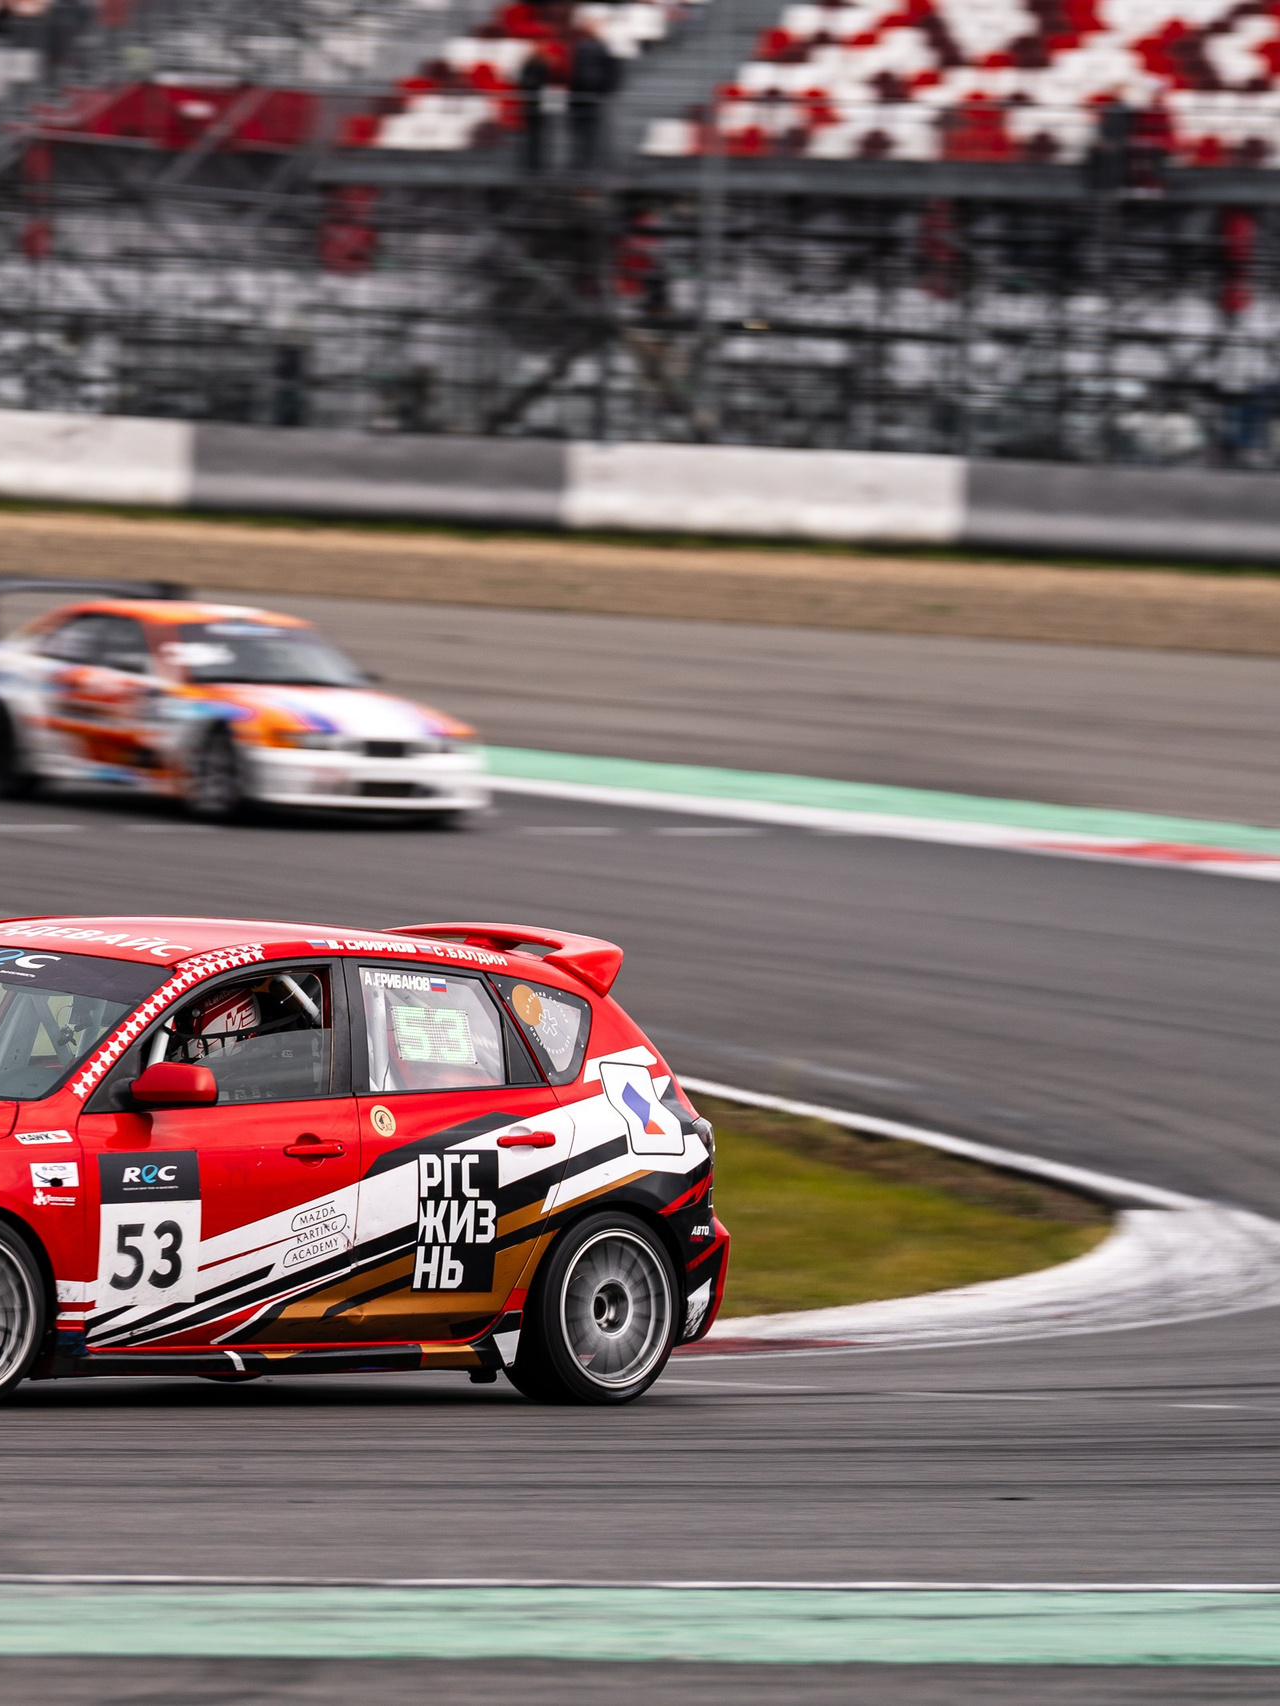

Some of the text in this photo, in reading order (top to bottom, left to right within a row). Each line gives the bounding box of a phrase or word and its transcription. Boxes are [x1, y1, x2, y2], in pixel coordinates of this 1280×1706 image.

[344, 939, 418, 954] СМИРНОВ
[364, 971, 431, 992] А.ГРИБАНОВ
[396, 1006, 469, 1061] 53
[19, 1133, 52, 1142] HAWK
[419, 1154, 480, 1198] РГС
[299, 1206, 336, 1225] MAZDA
[417, 1200, 497, 1244] ЖИЗ
[296, 1221, 338, 1244] KARTING
[109, 1220, 183, 1290] 53
[291, 1237, 339, 1262] ACADEMY
[413, 1246, 464, 1289] НЬ
